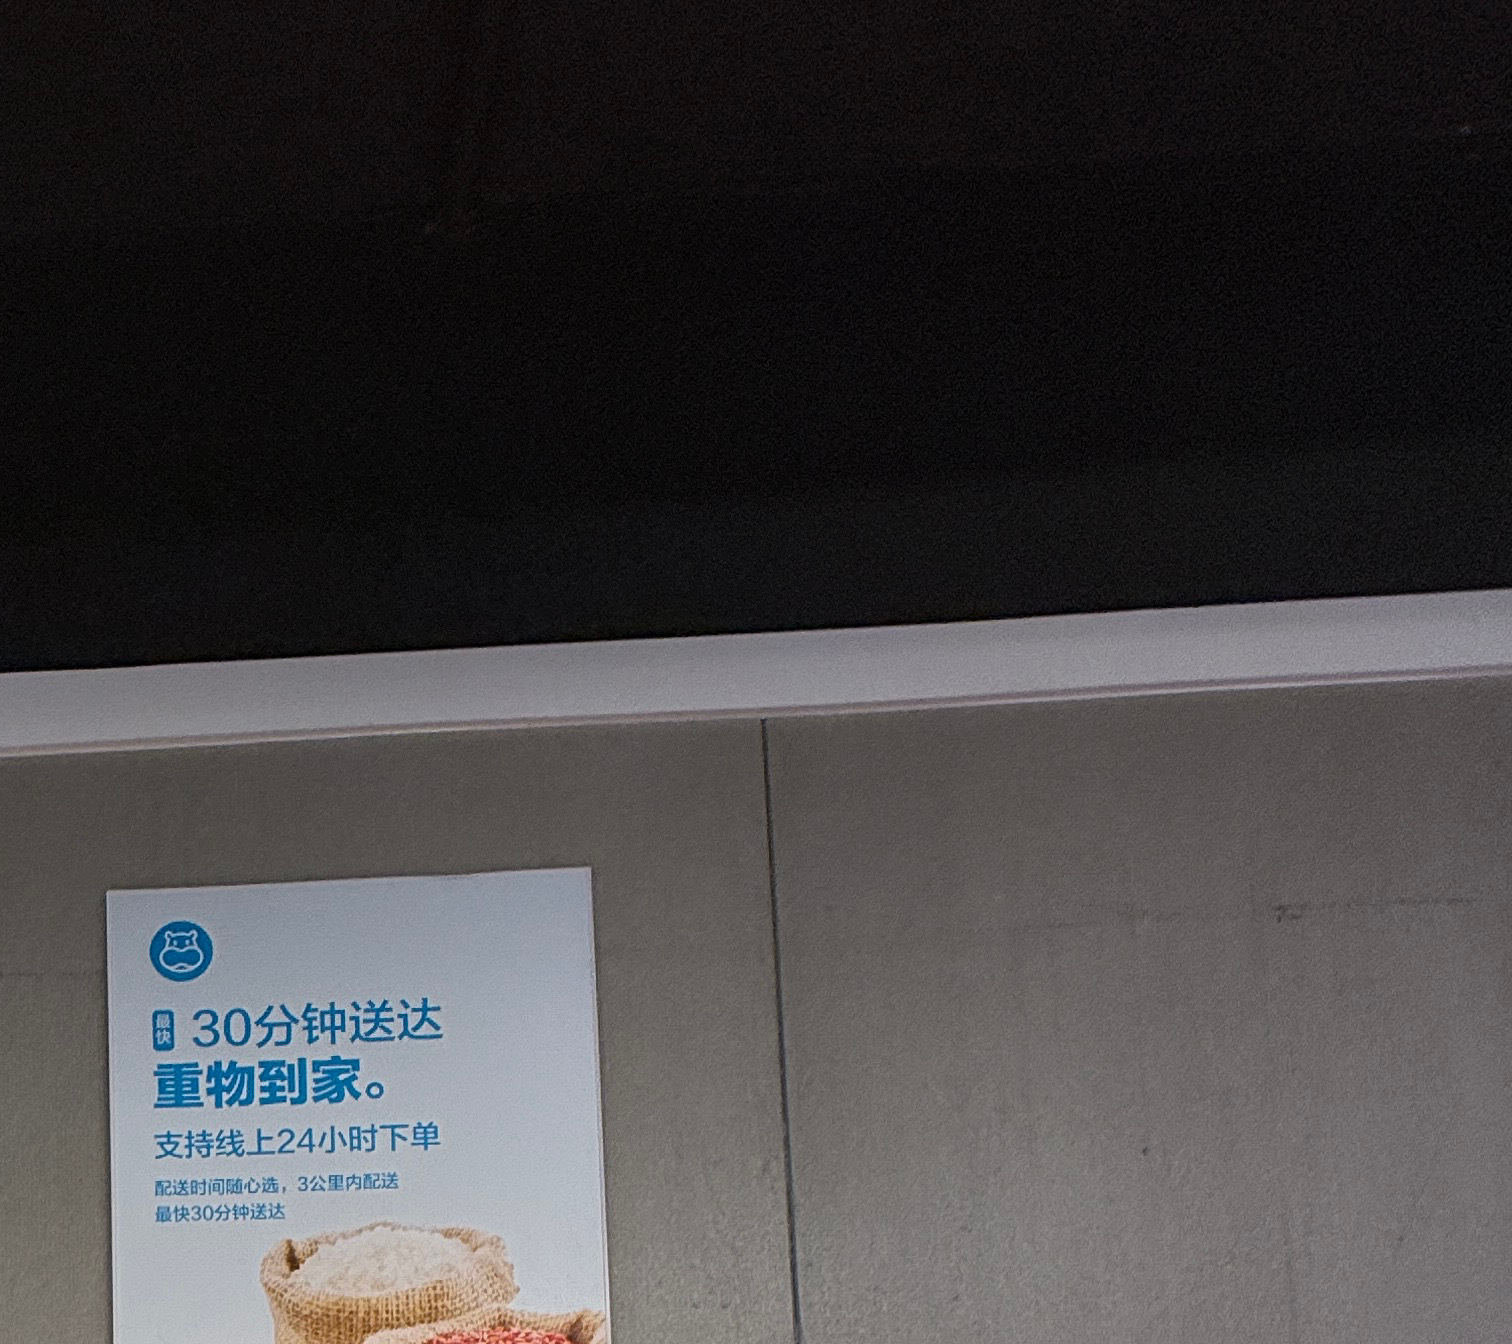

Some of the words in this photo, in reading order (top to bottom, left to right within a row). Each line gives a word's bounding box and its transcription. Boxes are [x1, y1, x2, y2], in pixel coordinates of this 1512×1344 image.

[192, 998, 443, 1048] 30分钟送达
[153, 1055, 385, 1109] 重物到家。
[153, 1121, 441, 1160] 支持线上24小时下单
[155, 1202, 286, 1223] 最快30分钟送达
